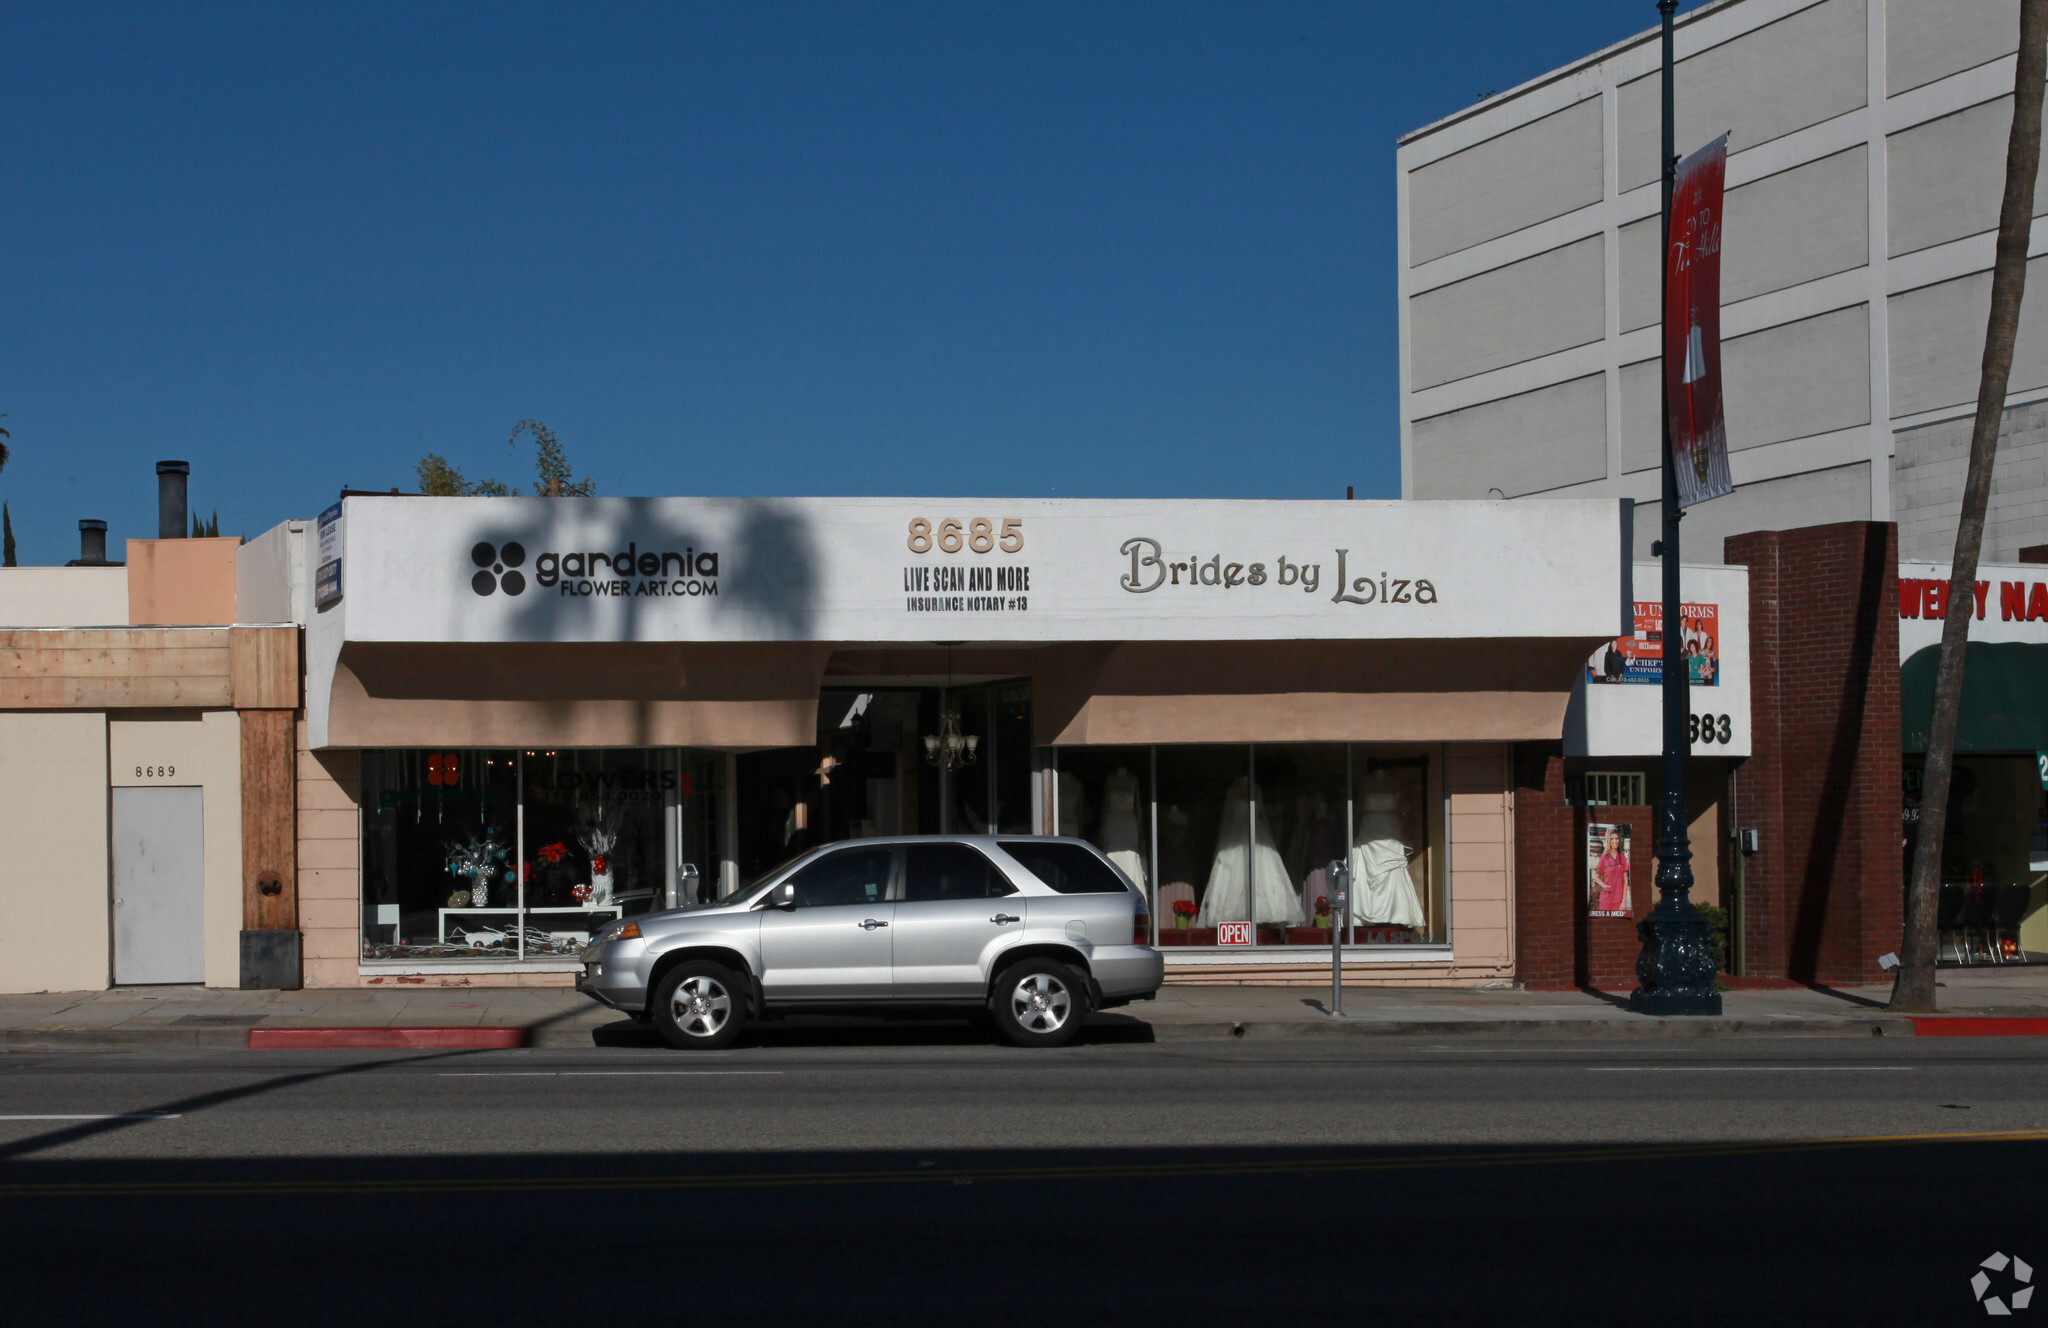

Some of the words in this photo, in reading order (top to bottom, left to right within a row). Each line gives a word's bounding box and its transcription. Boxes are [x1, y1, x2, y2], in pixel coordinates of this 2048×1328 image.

[907, 517, 1024, 553] 8685
[536, 542, 718, 587] gardenia
[1120, 537, 1268, 593] Brides
[1278, 555, 1321, 592] by
[1331, 548, 1438, 605] Liza
[560, 580, 631, 596] FLOWER
[635, 580, 718, 596] ART.COM
[904, 567, 929, 592] LIVE
[933, 566, 964, 592] SCAN
[969, 567, 993, 592] AND
[997, 566, 1030, 592] MORE
[907, 596, 964, 611] INSURANCE
[967, 596, 1005, 611] NOTARY
[1008, 596, 1028, 611] #13
[1899, 578, 1990, 620] WEY
[1648, 604, 1714, 618] UNORMS
[135, 766, 175, 777] 8689
[1220, 925, 1249, 943] OPEN
[1366, 931, 1386, 944] LA
